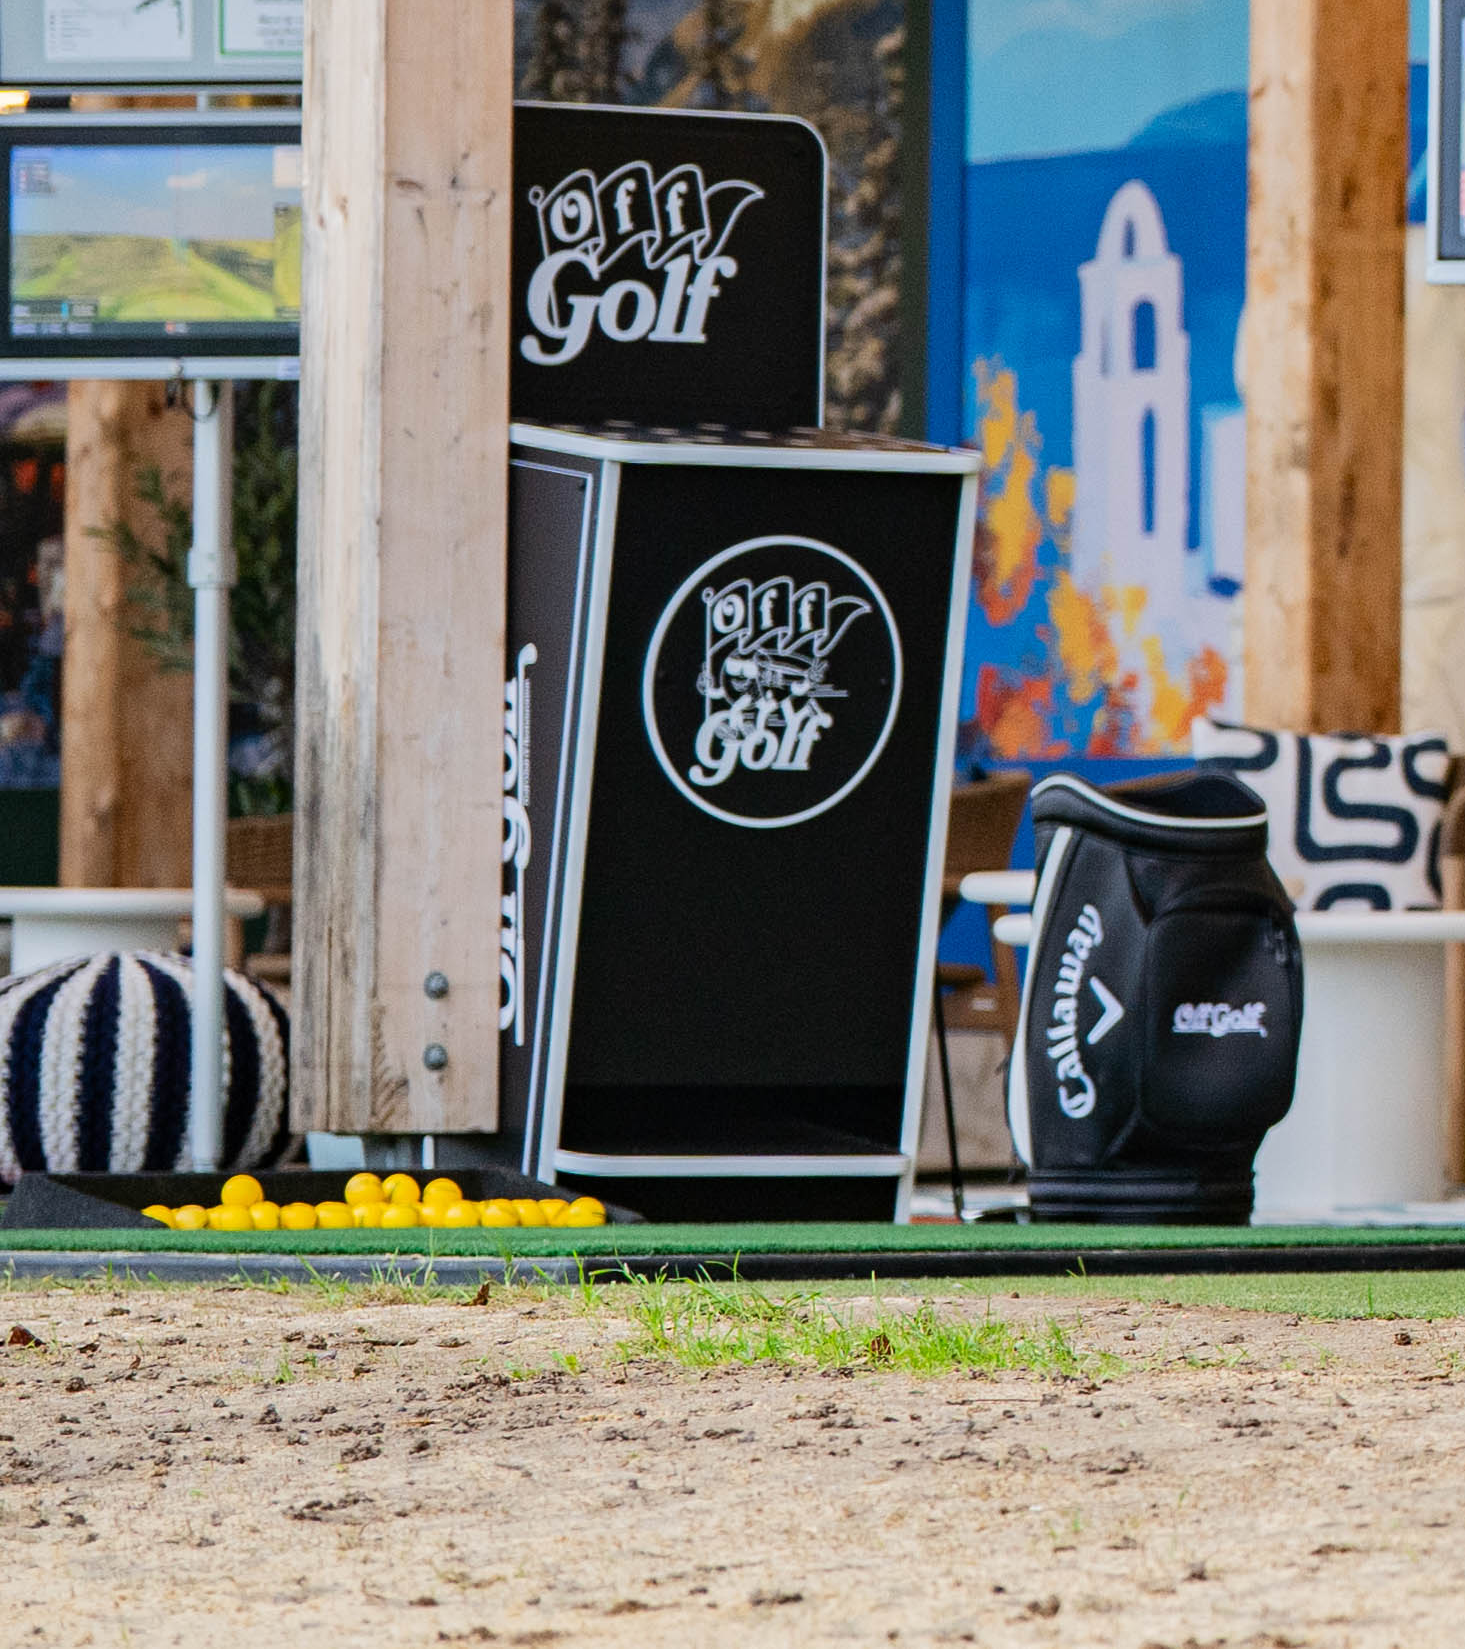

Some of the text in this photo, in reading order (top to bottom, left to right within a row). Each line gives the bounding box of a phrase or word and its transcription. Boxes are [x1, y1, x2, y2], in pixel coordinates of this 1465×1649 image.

[550, 178, 689, 243] Off
[520, 250, 738, 366] Golf
[712, 588, 817, 634] Off
[1046, 904, 1103, 1119] Callaway
